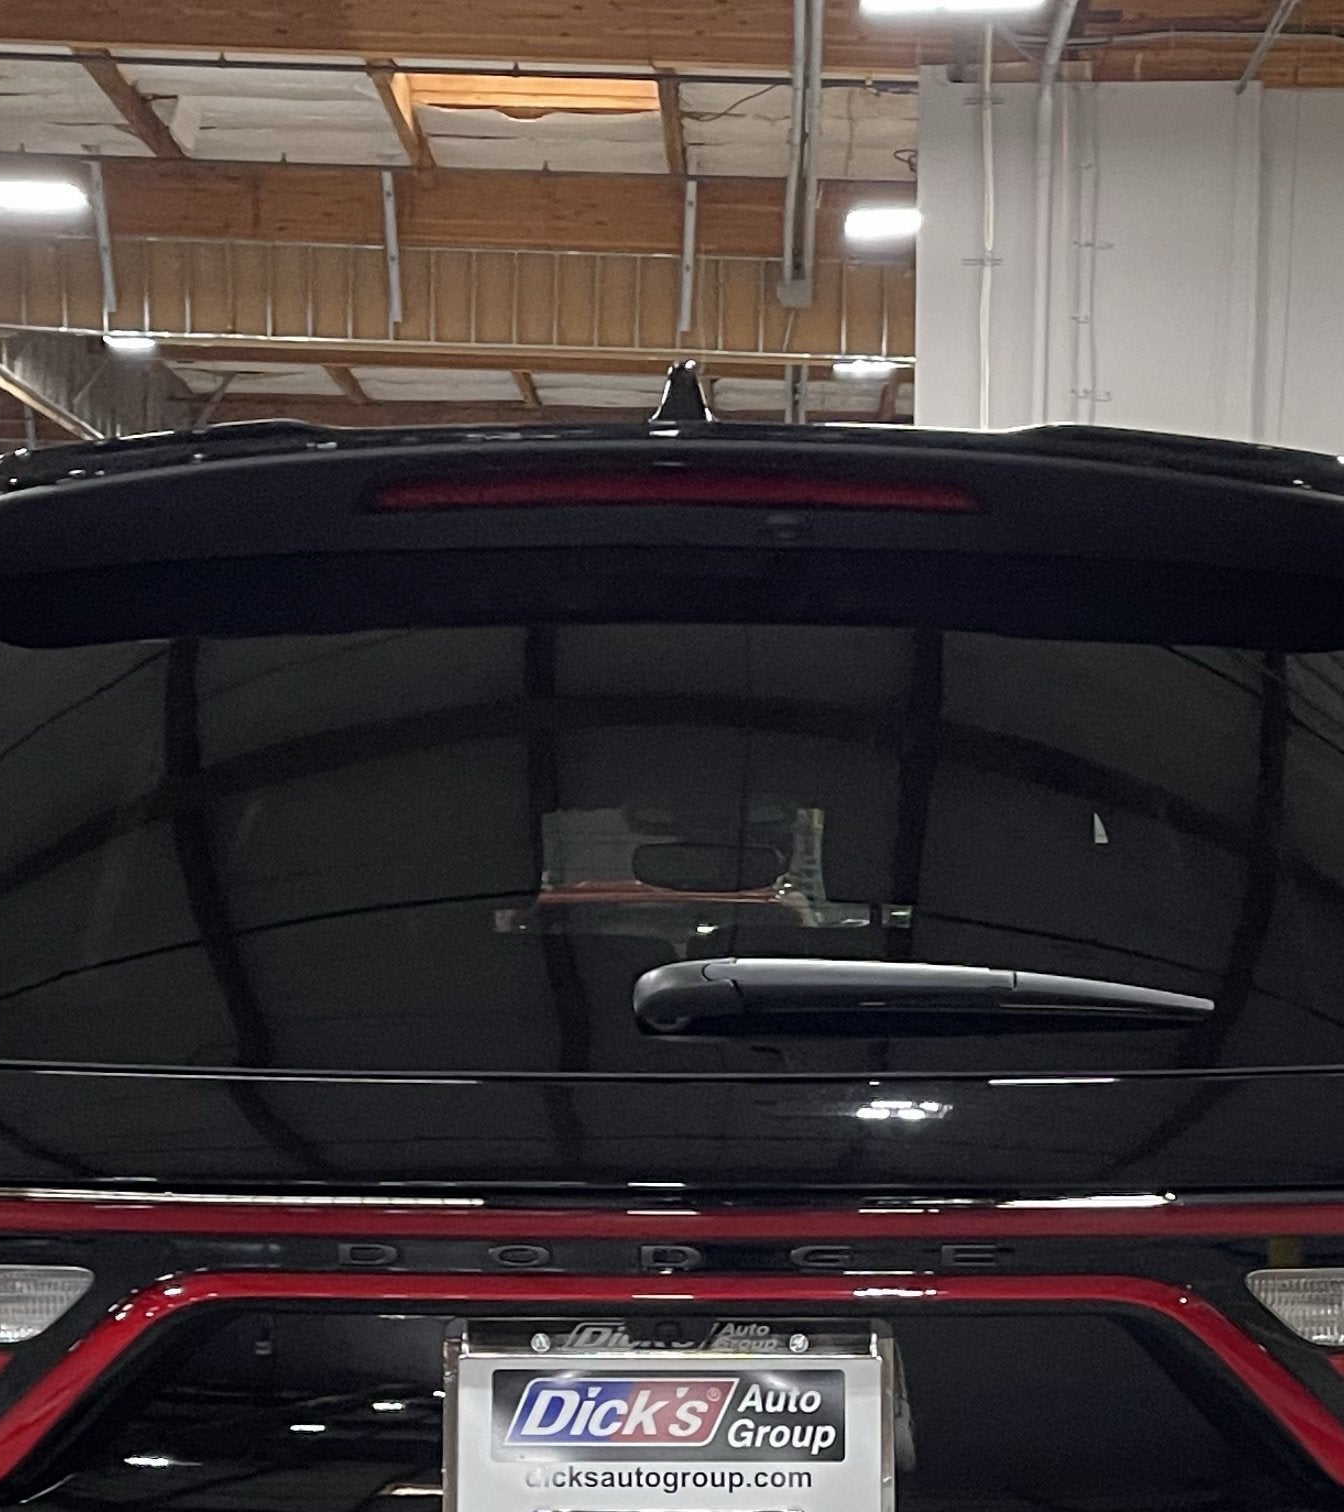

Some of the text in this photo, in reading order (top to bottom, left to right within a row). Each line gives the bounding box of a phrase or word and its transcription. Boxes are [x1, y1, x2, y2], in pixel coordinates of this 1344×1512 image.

[338, 1242, 999, 1270] DODGE
[720, 1323, 770, 1336] Auto
[521, 1387, 708, 1437] Dick's
[737, 1384, 822, 1413] Auto
[727, 1420, 836, 1455] Group
[525, 1466, 812, 1492] dicksautogroup.com
